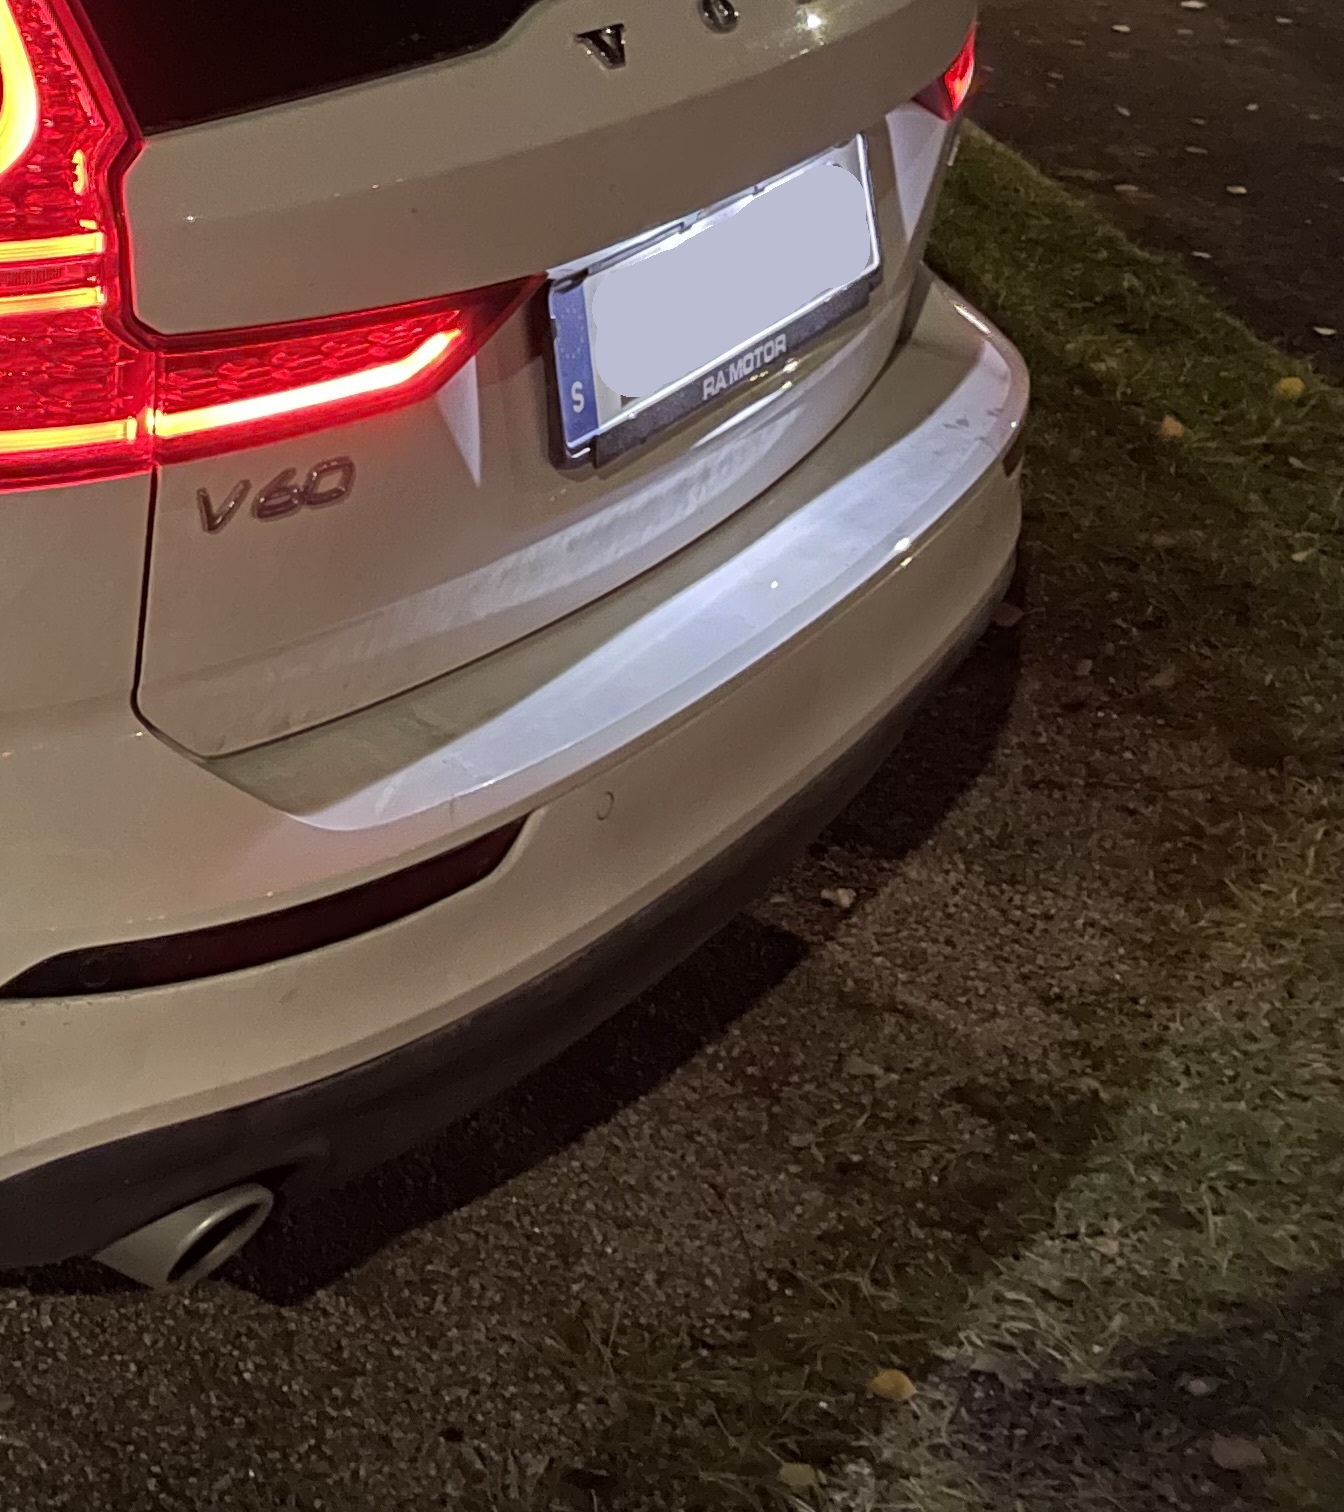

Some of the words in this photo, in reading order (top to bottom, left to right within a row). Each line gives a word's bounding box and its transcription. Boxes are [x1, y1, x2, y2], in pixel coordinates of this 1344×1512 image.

[728, 333, 787, 385] MOTOR
[571, 380, 585, 414] S
[196, 455, 356, 535] V60
